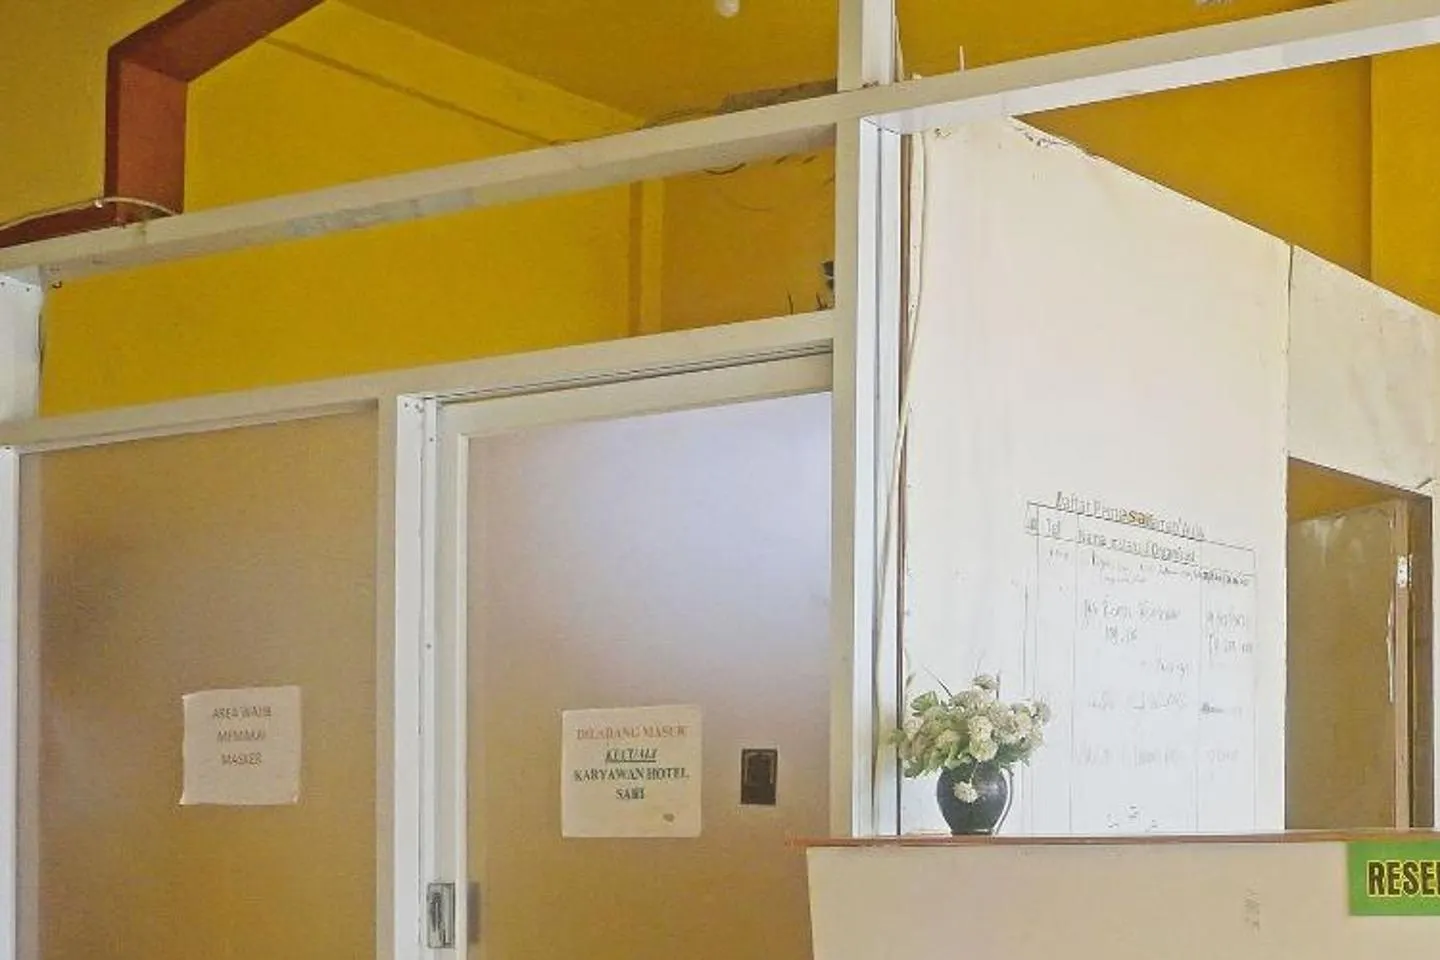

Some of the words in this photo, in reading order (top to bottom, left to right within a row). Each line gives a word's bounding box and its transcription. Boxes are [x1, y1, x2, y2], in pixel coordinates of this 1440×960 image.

[574, 768, 645, 781] KARYAWAN
[647, 767, 690, 780] HOTEL
[615, 788, 645, 800] SARI
